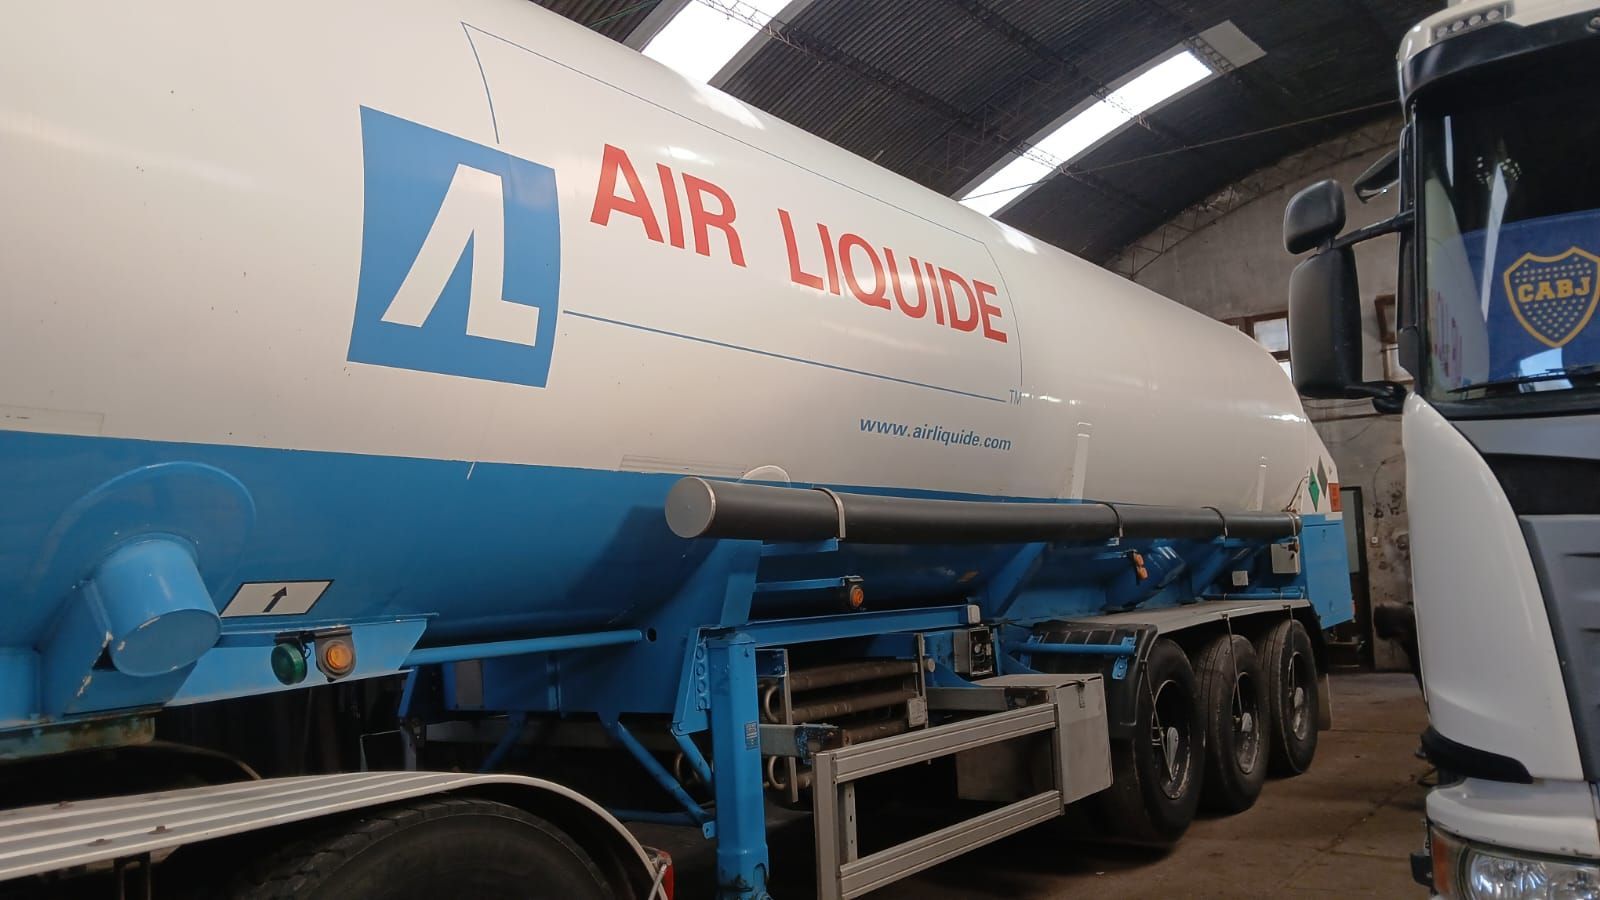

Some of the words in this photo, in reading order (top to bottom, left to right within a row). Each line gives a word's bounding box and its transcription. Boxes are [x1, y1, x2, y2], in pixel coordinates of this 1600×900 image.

[590, 143, 747, 268] AIR
[777, 208, 1007, 343] LIQUIDE
[1518, 276, 1591, 303] CABJ
[859, 418, 1012, 451] www.airliquide.com
